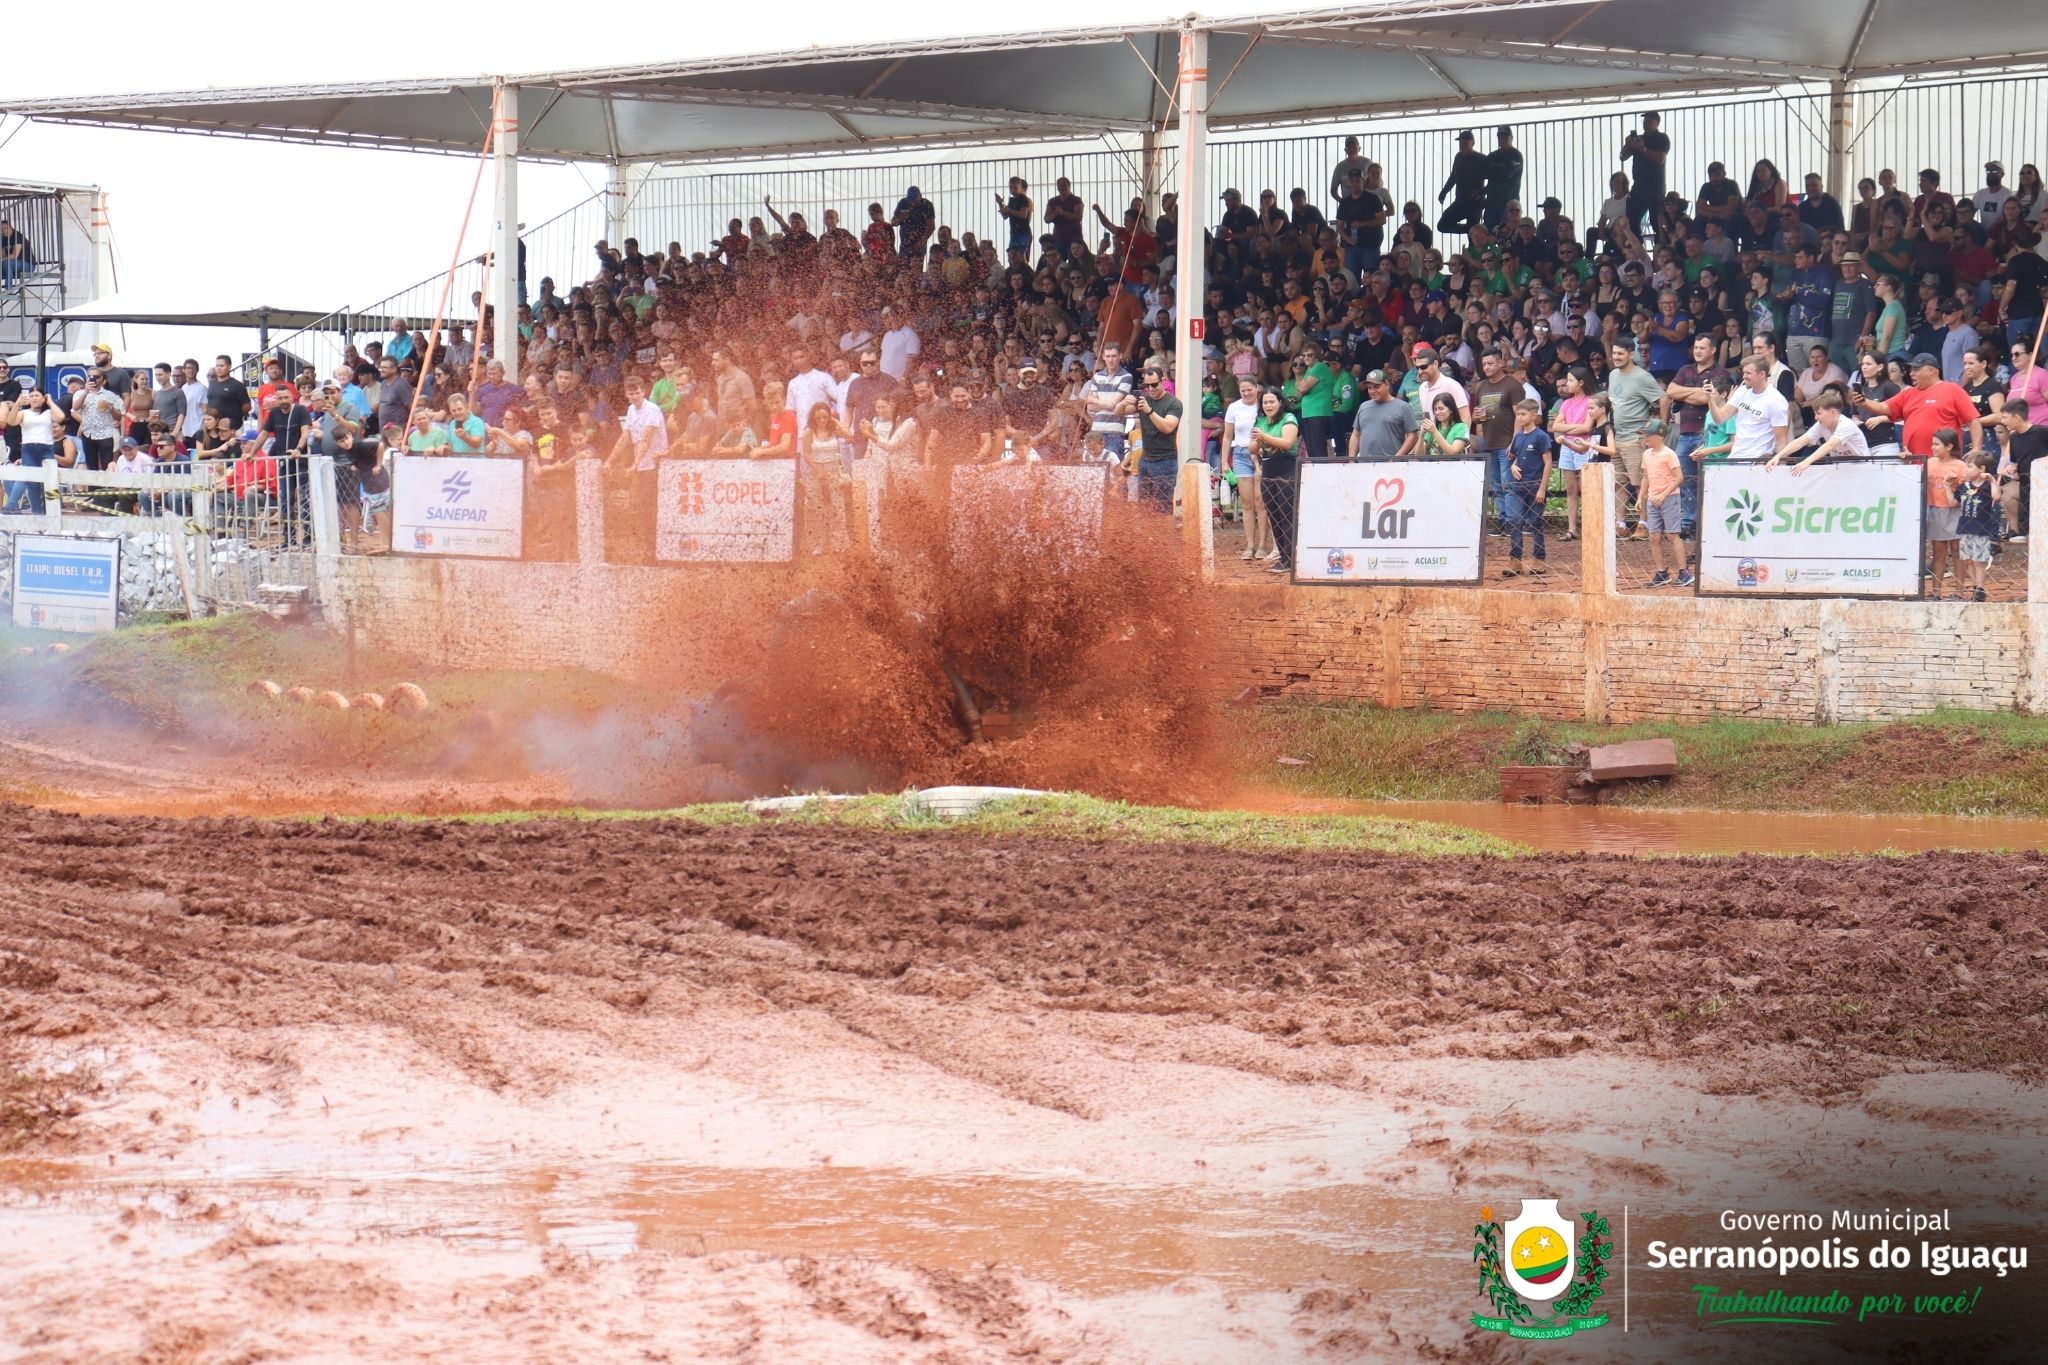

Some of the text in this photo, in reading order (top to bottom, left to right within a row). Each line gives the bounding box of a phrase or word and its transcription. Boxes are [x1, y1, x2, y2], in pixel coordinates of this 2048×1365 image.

[712, 481, 772, 505] COPEL
[425, 506, 488, 522] SANEPAR
[1361, 501, 1415, 539] Lar
[1771, 496, 1899, 533] Sicredi
[1415, 557, 1438, 565] ACIASI
[26, 563, 52, 575] ITAIPU
[53, 565, 80, 577] DIESEL
[1842, 568, 1870, 578] ACIASI
